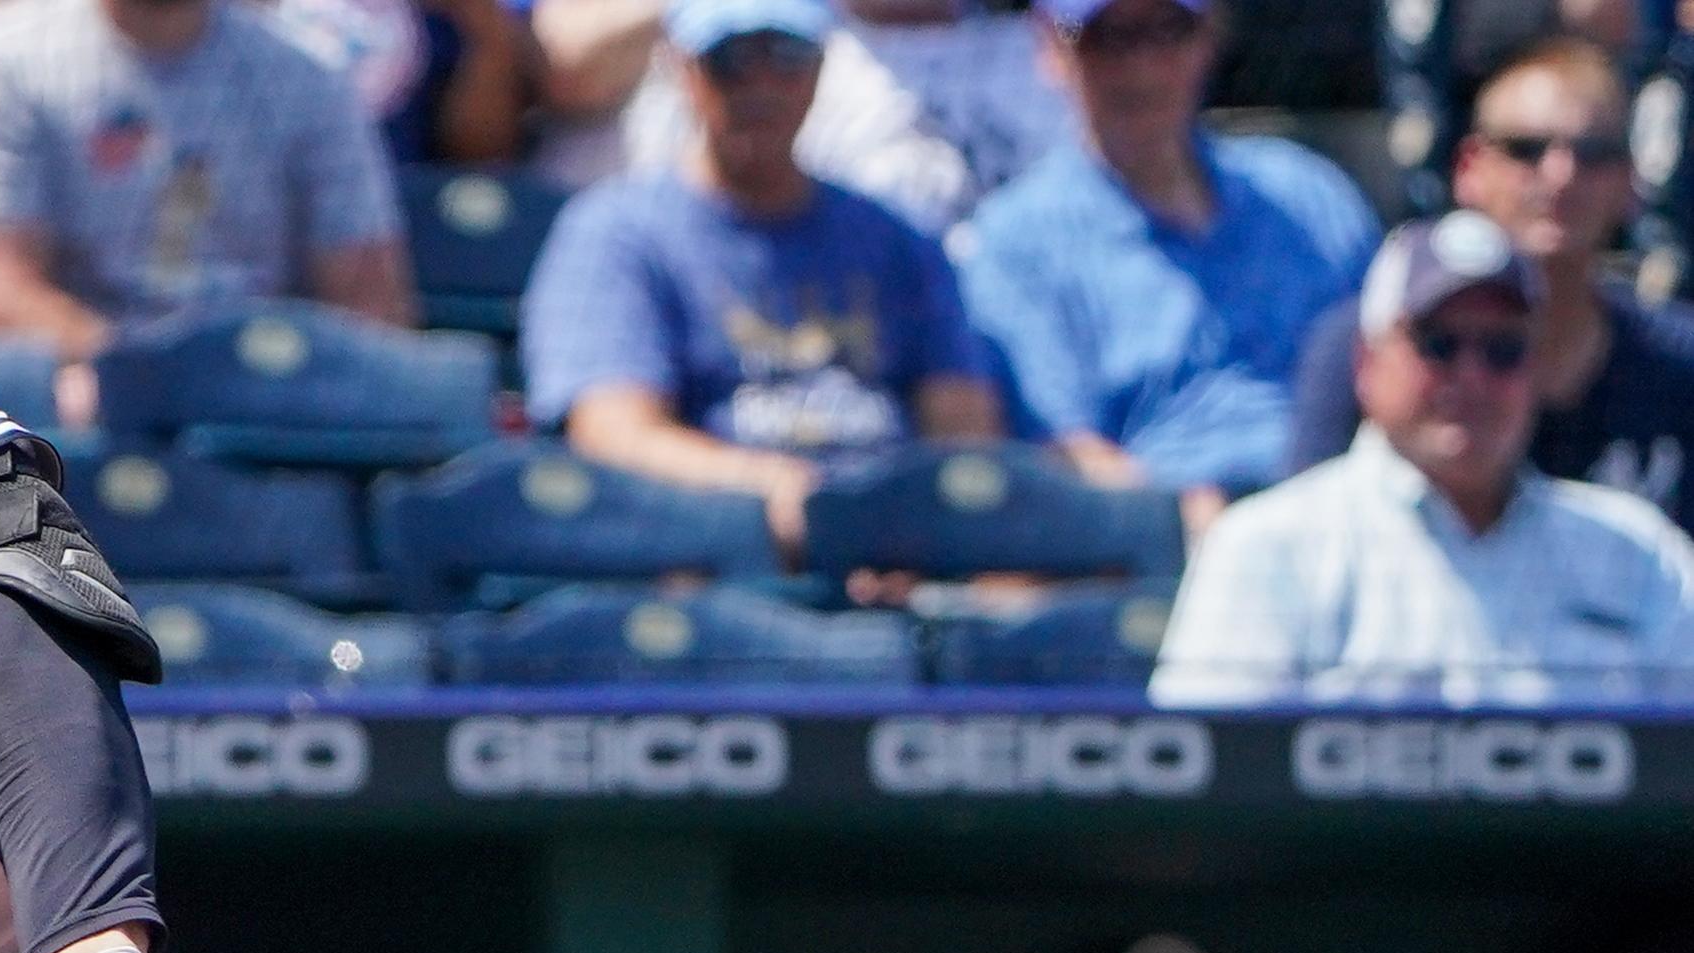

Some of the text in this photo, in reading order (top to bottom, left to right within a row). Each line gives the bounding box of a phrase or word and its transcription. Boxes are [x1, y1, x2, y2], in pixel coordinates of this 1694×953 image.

[446, 716, 789, 795] GEICO
[869, 715, 1214, 793] GEICO
[1291, 717, 1635, 798] GEICO
